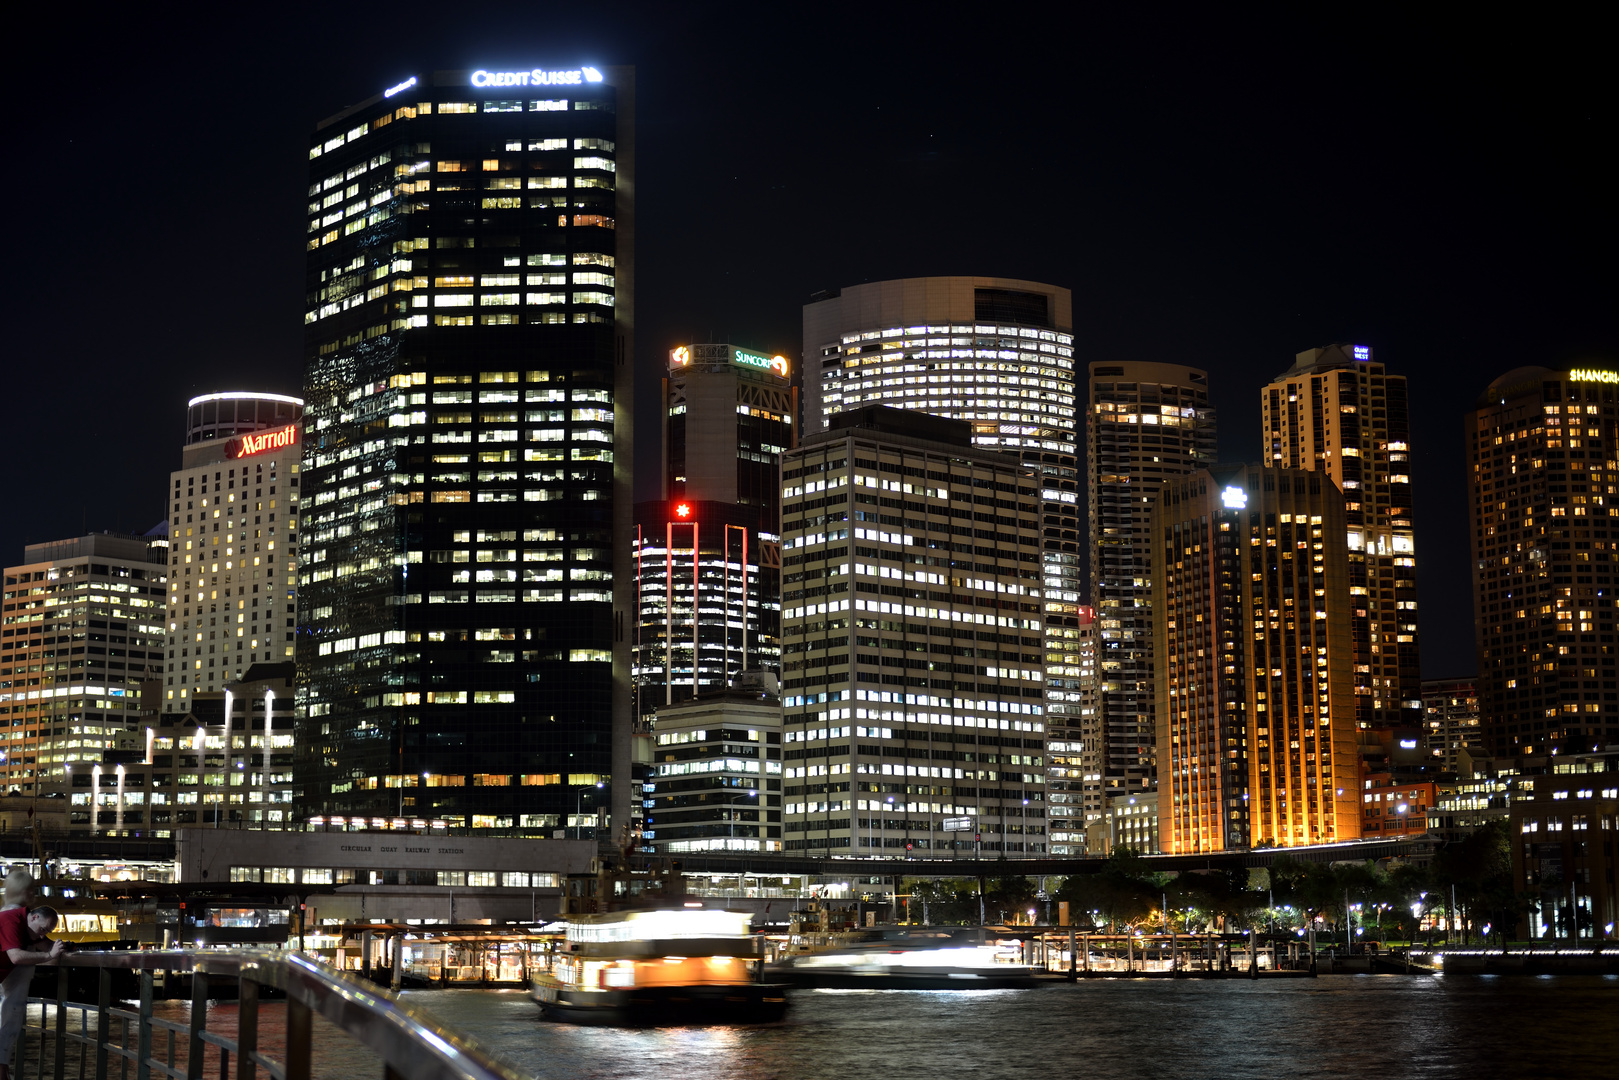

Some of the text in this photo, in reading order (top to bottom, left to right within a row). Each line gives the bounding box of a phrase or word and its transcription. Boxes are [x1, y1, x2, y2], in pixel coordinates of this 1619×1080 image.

[471, 68, 582, 87] CREDIT SUISSE
[735, 350, 772, 369] SUNCORP
[237, 424, 296, 458] Marriott
